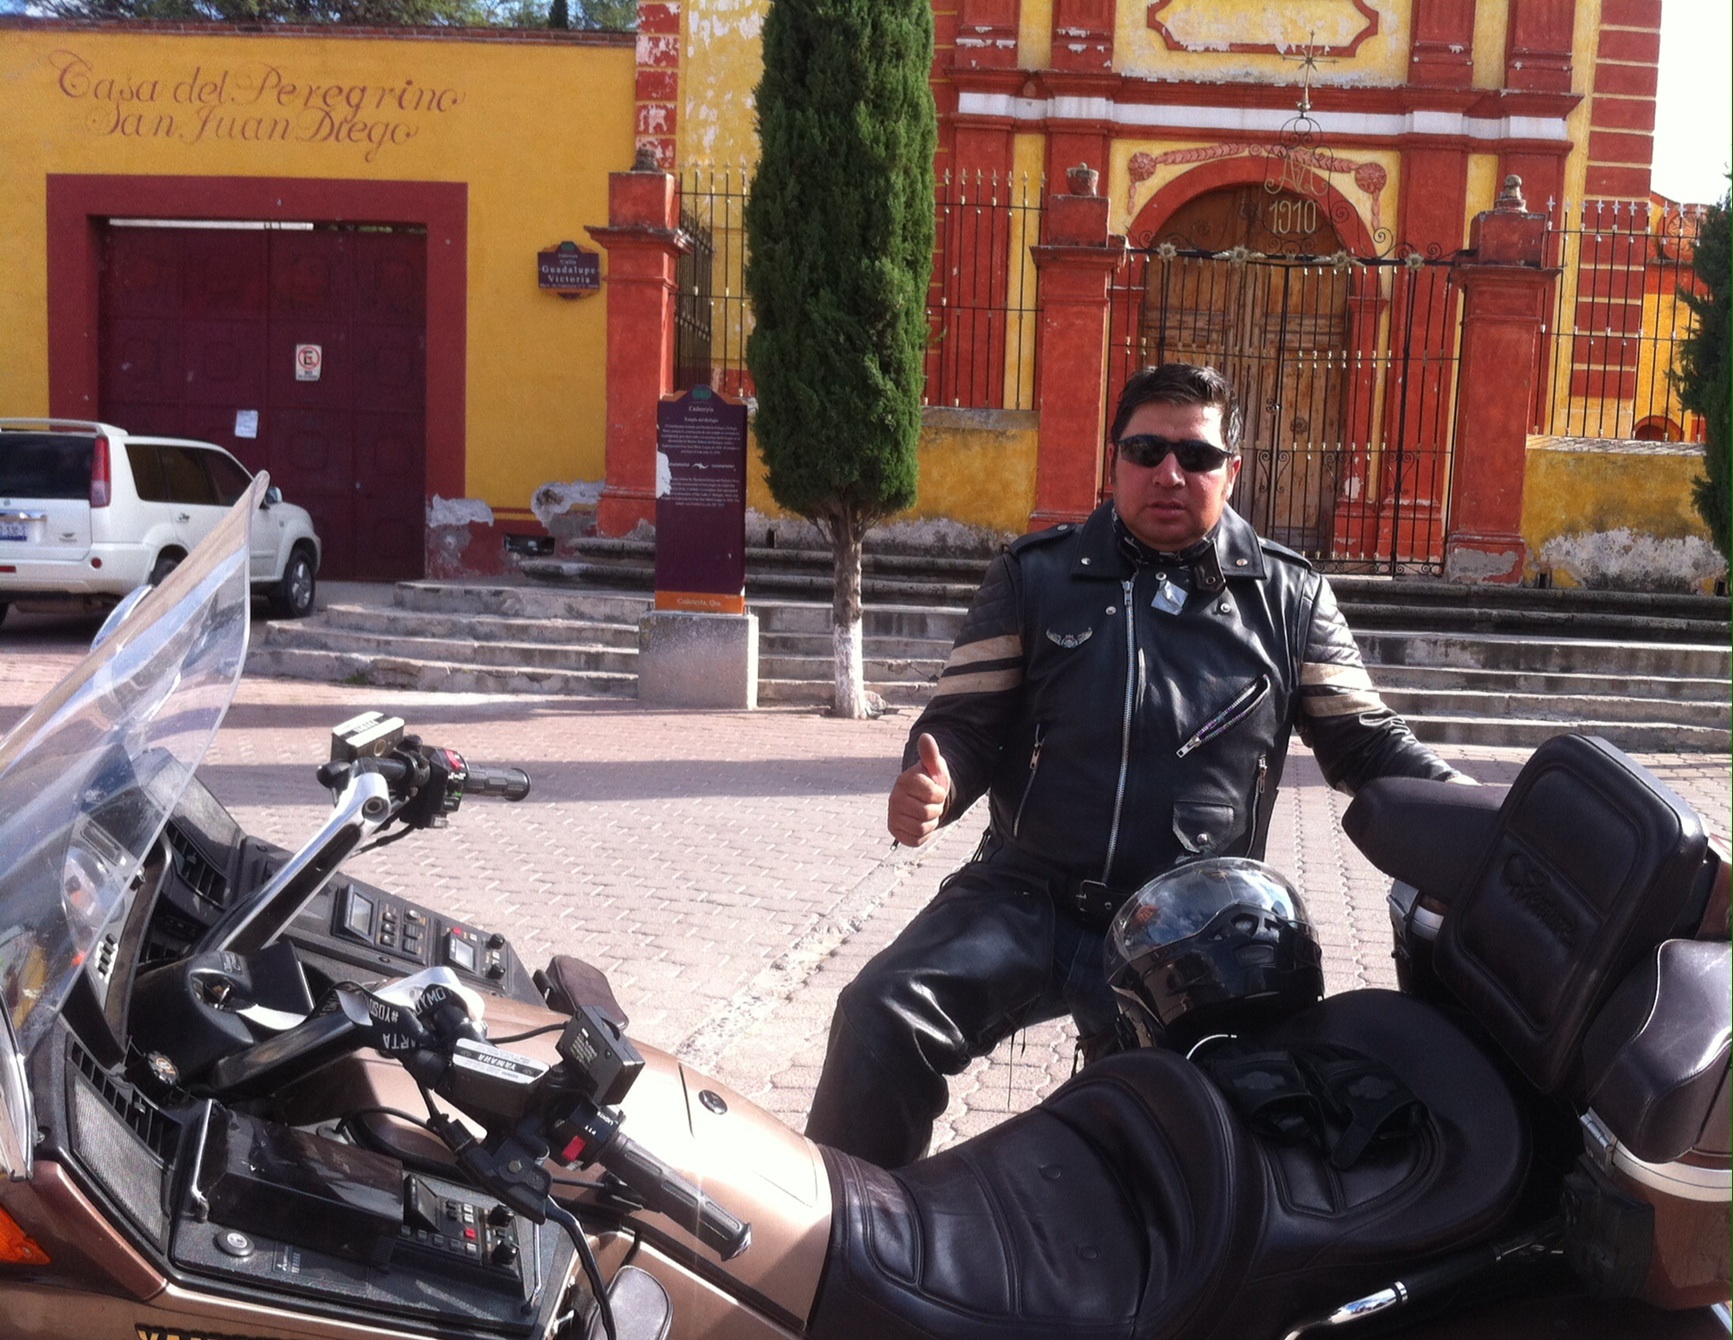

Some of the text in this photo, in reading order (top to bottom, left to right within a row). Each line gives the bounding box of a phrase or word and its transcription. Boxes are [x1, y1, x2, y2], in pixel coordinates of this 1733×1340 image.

[50, 50, 466, 124] Casa del Peregrino
[86, 99, 420, 163] San Juan Diego
[1269, 200, 1317, 234] 1910
[541, 265, 596, 275] Guadalupe
[548, 274, 590, 283] Victoria
[477, 1053, 517, 1071] YAMAHA
